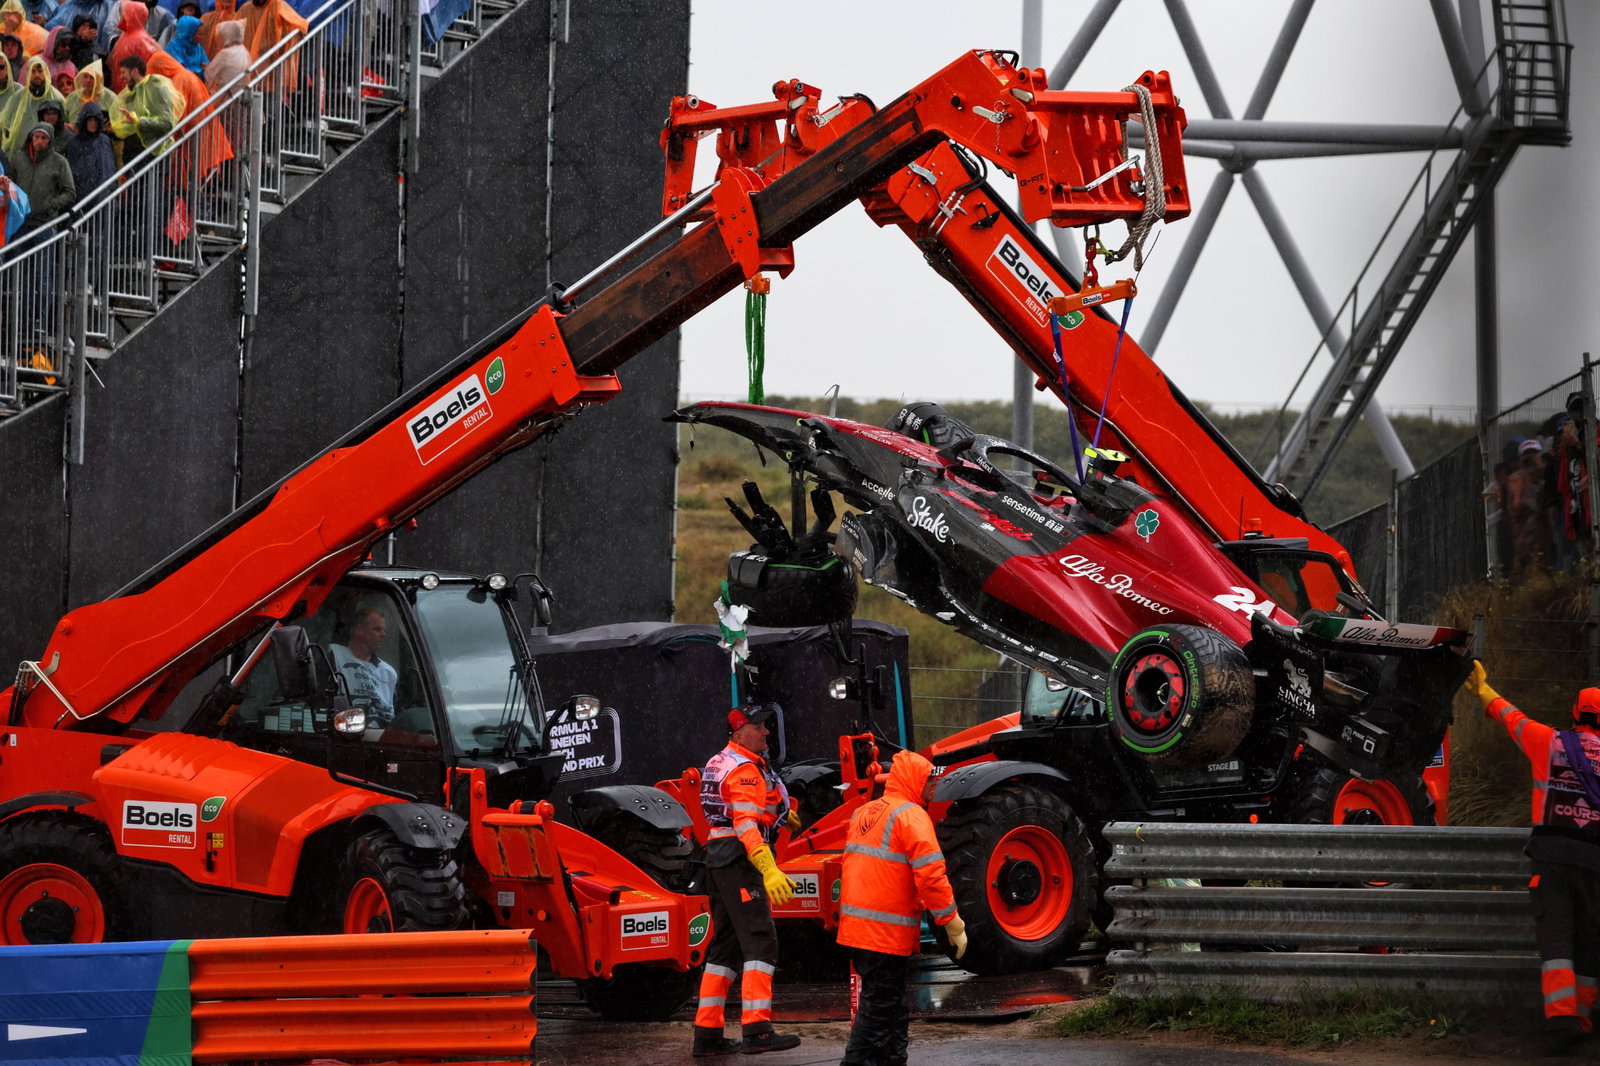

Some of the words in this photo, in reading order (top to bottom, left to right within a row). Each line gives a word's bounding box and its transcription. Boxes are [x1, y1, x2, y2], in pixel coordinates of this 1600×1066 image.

[998, 240, 1056, 305] Boels
[1025, 296, 1047, 322] RENTAL
[1083, 296, 1102, 304] Boels
[488, 370, 502, 383] eco
[411, 387, 481, 444] Boels
[462, 407, 488, 429] RENTAL
[1002, 494, 1045, 524] sensetime
[907, 496, 950, 543] Stake
[1059, 554, 1107, 585] Alfa
[1105, 574, 1174, 615] Romeo
[1343, 626, 1377, 641] Alfa
[1377, 629, 1430, 645] Romeo
[550, 721, 590, 737] RMULA
[591, 719, 598, 729] 1
[551, 733, 591, 749] INEKEN
[579, 755, 605, 769] PRIX
[1208, 763, 1229, 771] STAGE
[126, 805, 193, 828] Boels
[168, 834, 192, 844] RENTAL
[623, 916, 667, 934] Boels
[690, 926, 704, 934] eco
[650, 935, 667, 944] RENTAL
